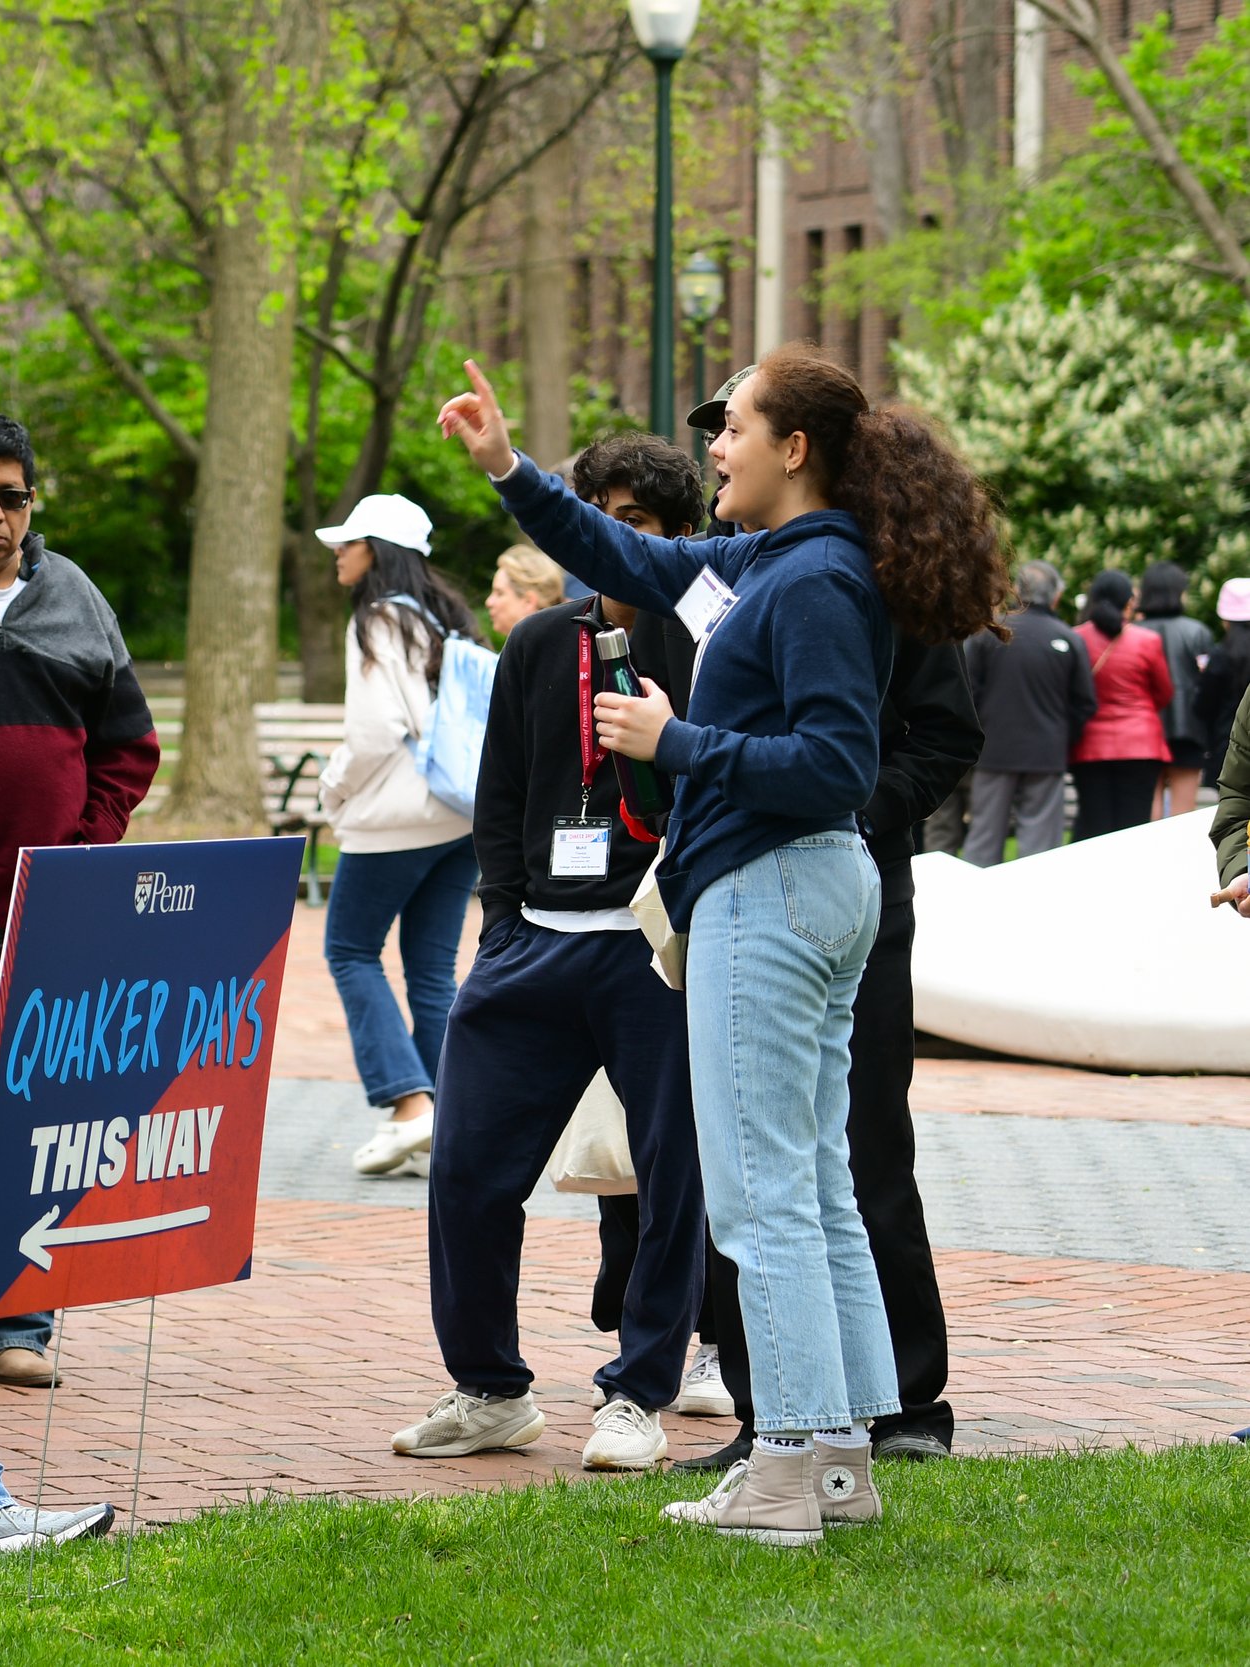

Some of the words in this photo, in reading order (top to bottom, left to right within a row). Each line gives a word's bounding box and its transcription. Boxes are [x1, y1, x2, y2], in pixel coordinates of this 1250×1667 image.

[150, 872, 195, 914] Penn
[5, 977, 169, 1102] QUAKER
[177, 976, 267, 1074] DAYS
[29, 1115, 128, 1195] THIS
[136, 1105, 224, 1183] WAY
